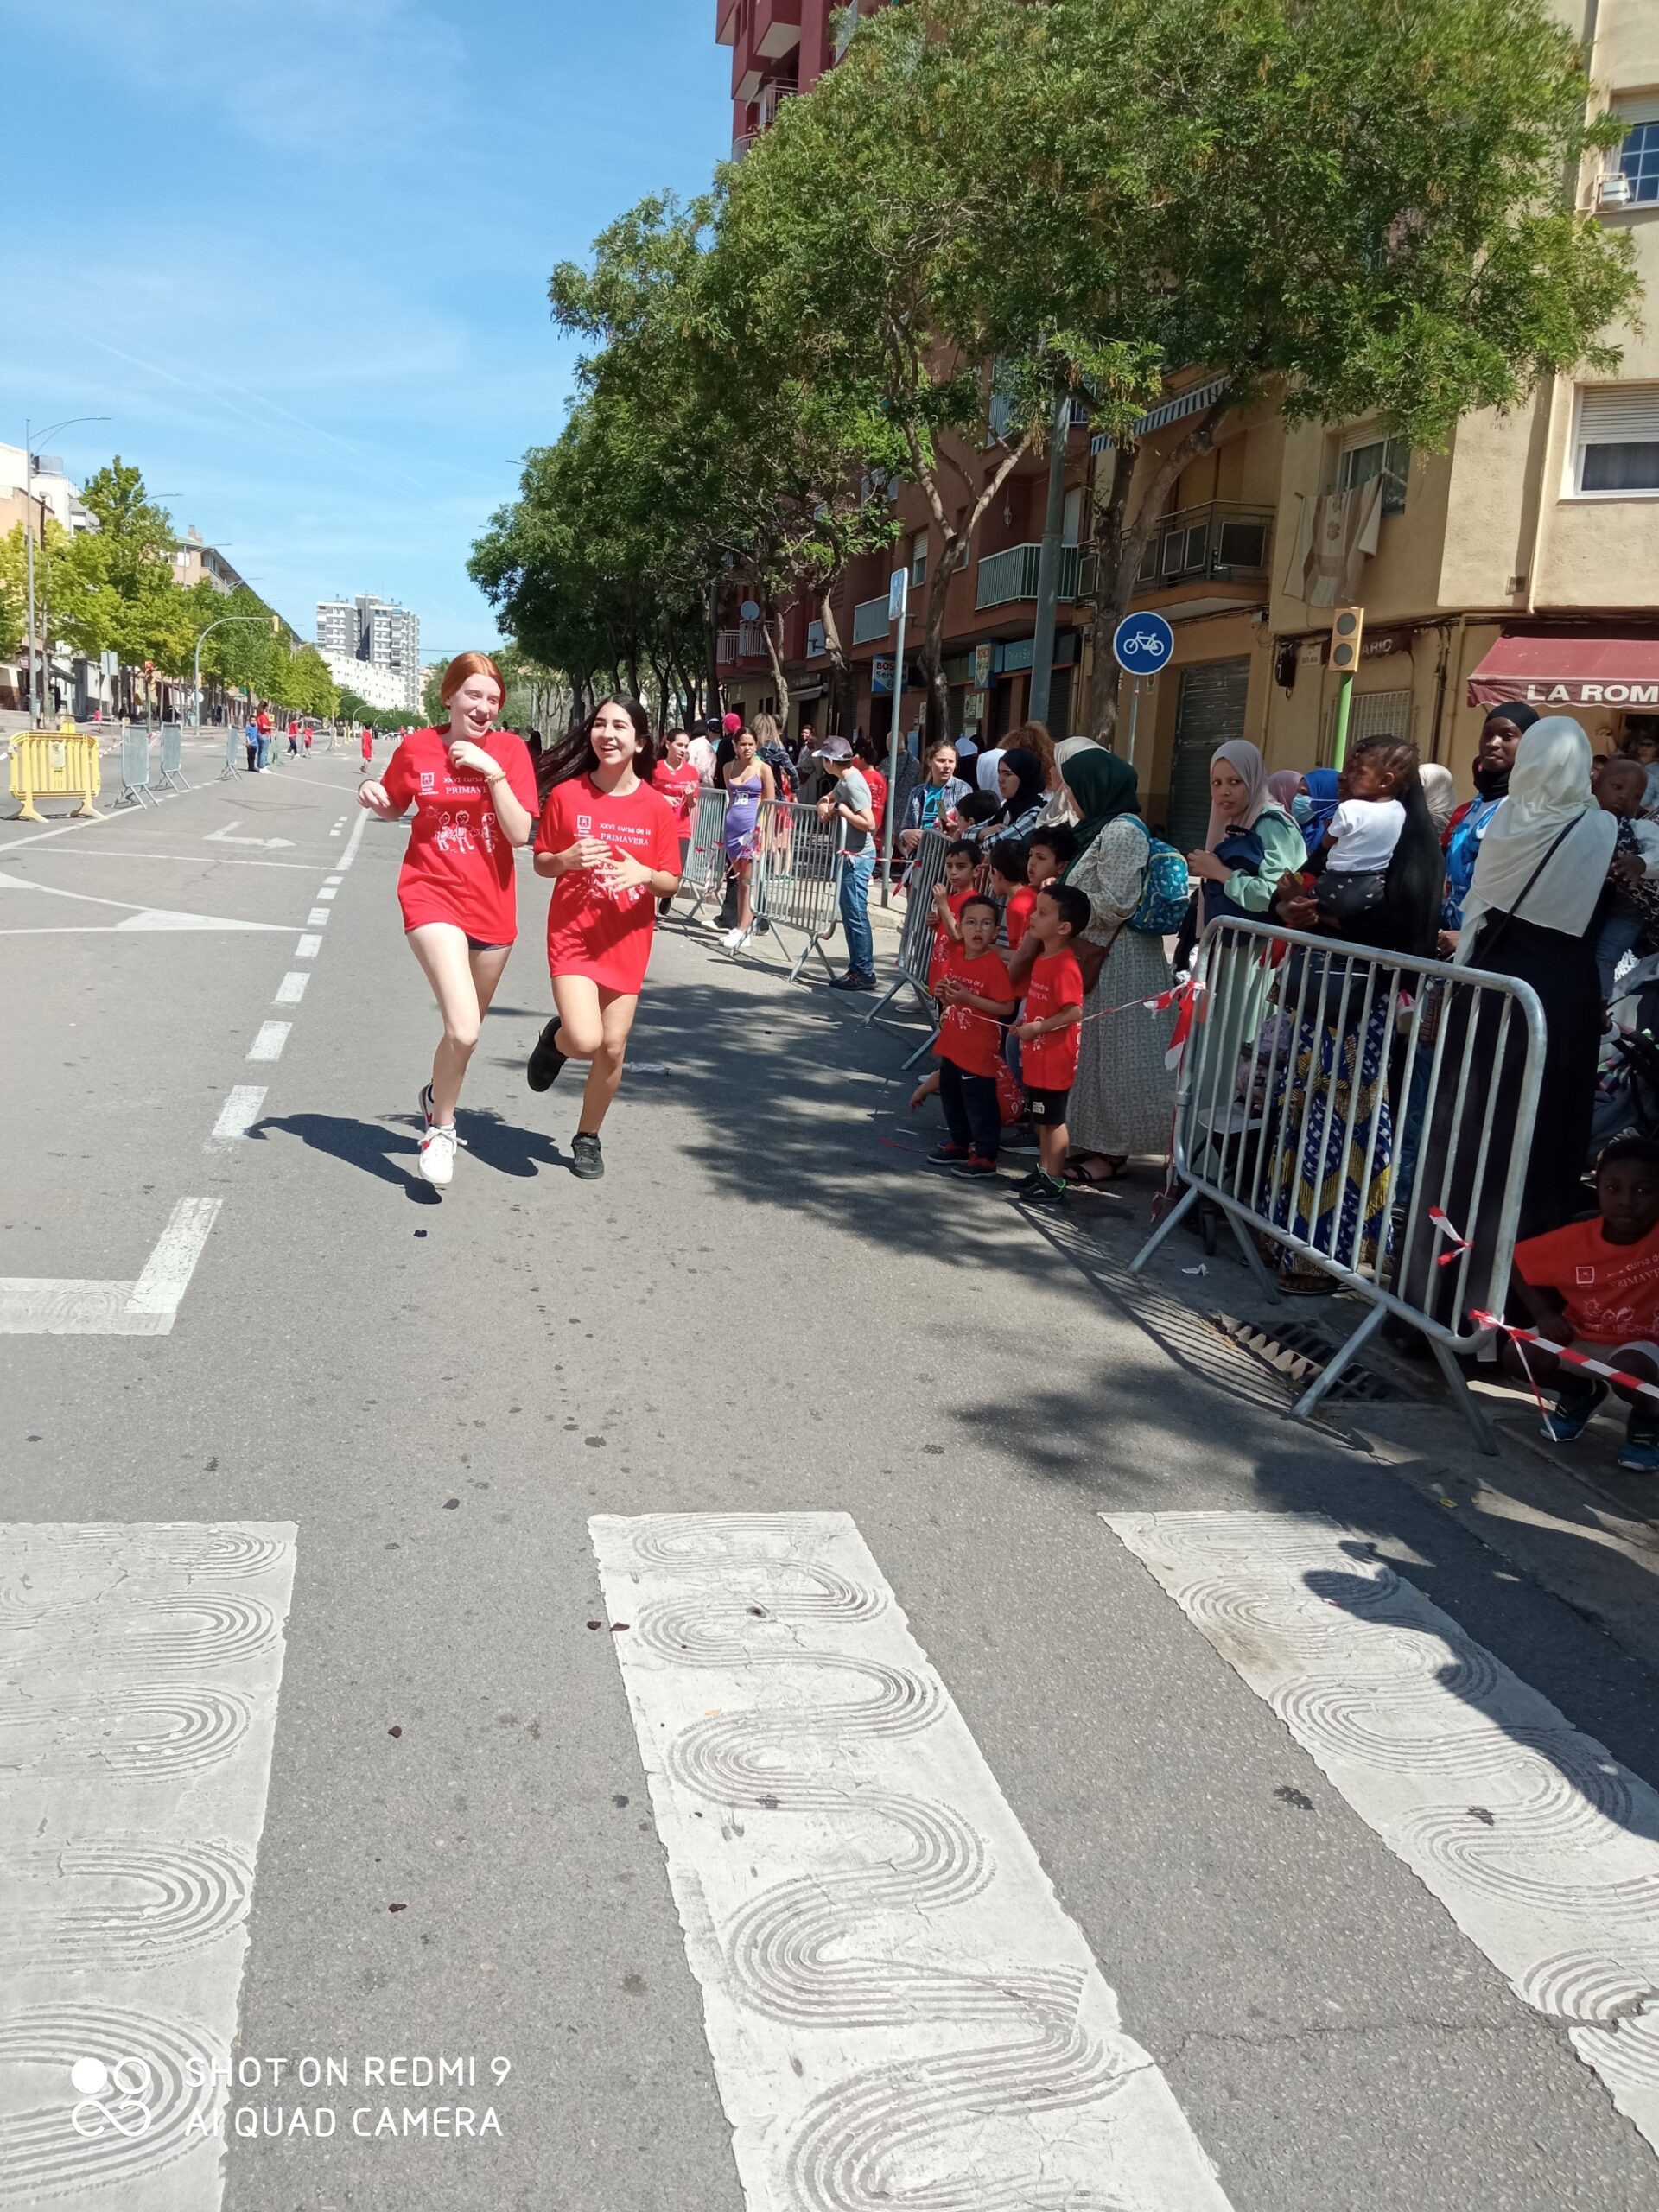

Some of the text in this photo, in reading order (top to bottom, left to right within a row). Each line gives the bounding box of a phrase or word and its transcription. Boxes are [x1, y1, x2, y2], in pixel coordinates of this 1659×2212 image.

[1526, 684, 1659, 702] LA ROM
[617, 824, 635, 834] cursa
[636, 826, 645, 835] de
[601, 832, 649, 845] PRIMAVERA
[1625, 1258, 1651, 1271] cursa
